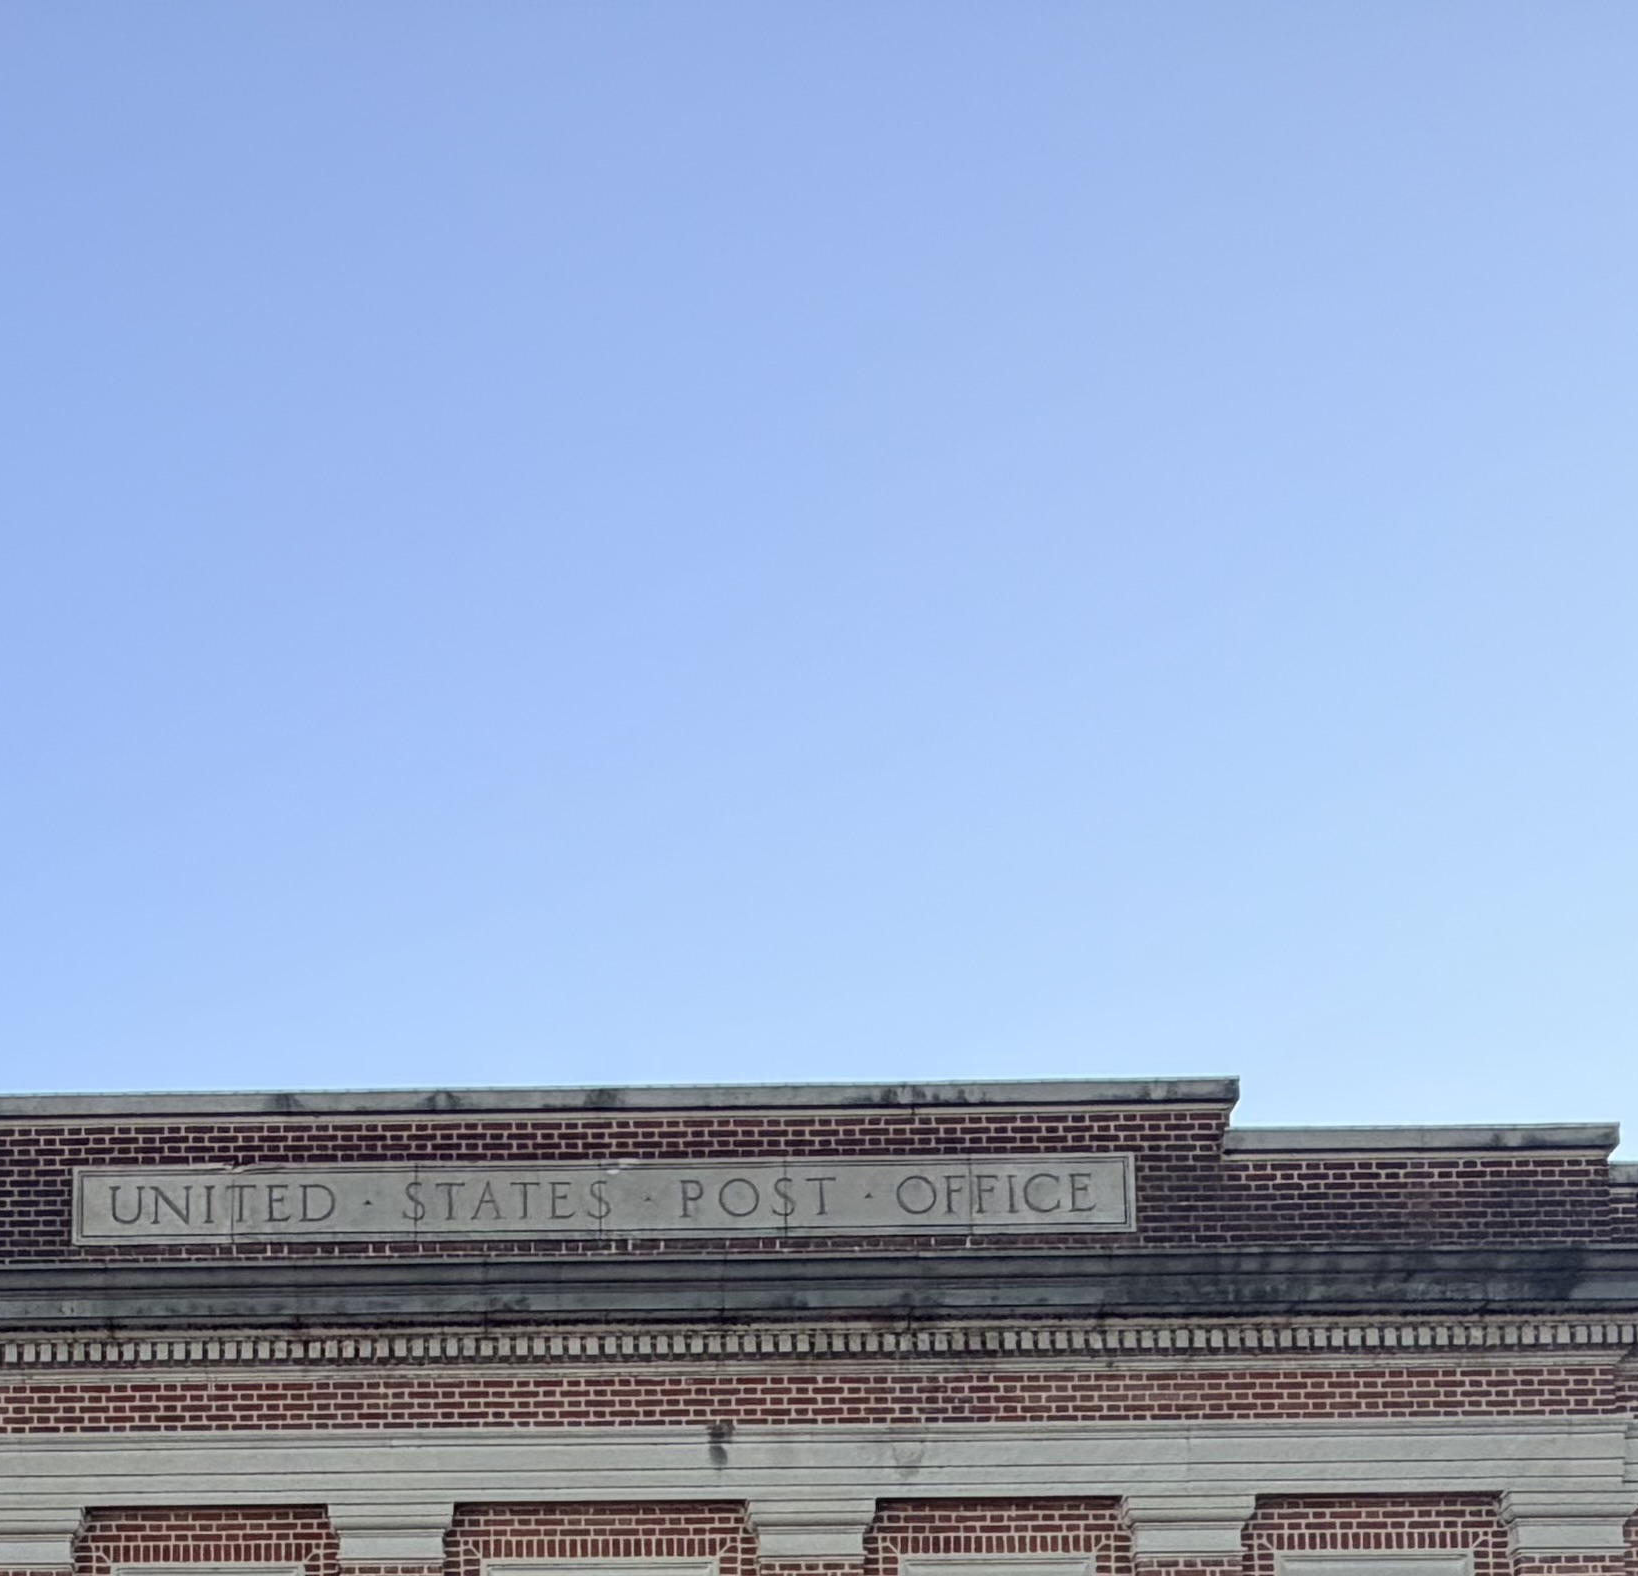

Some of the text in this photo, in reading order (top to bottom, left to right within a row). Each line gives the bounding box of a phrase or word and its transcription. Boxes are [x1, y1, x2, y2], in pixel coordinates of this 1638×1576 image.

[109, 1172, 1098, 1227] UNITED STATES POST OFFICE
